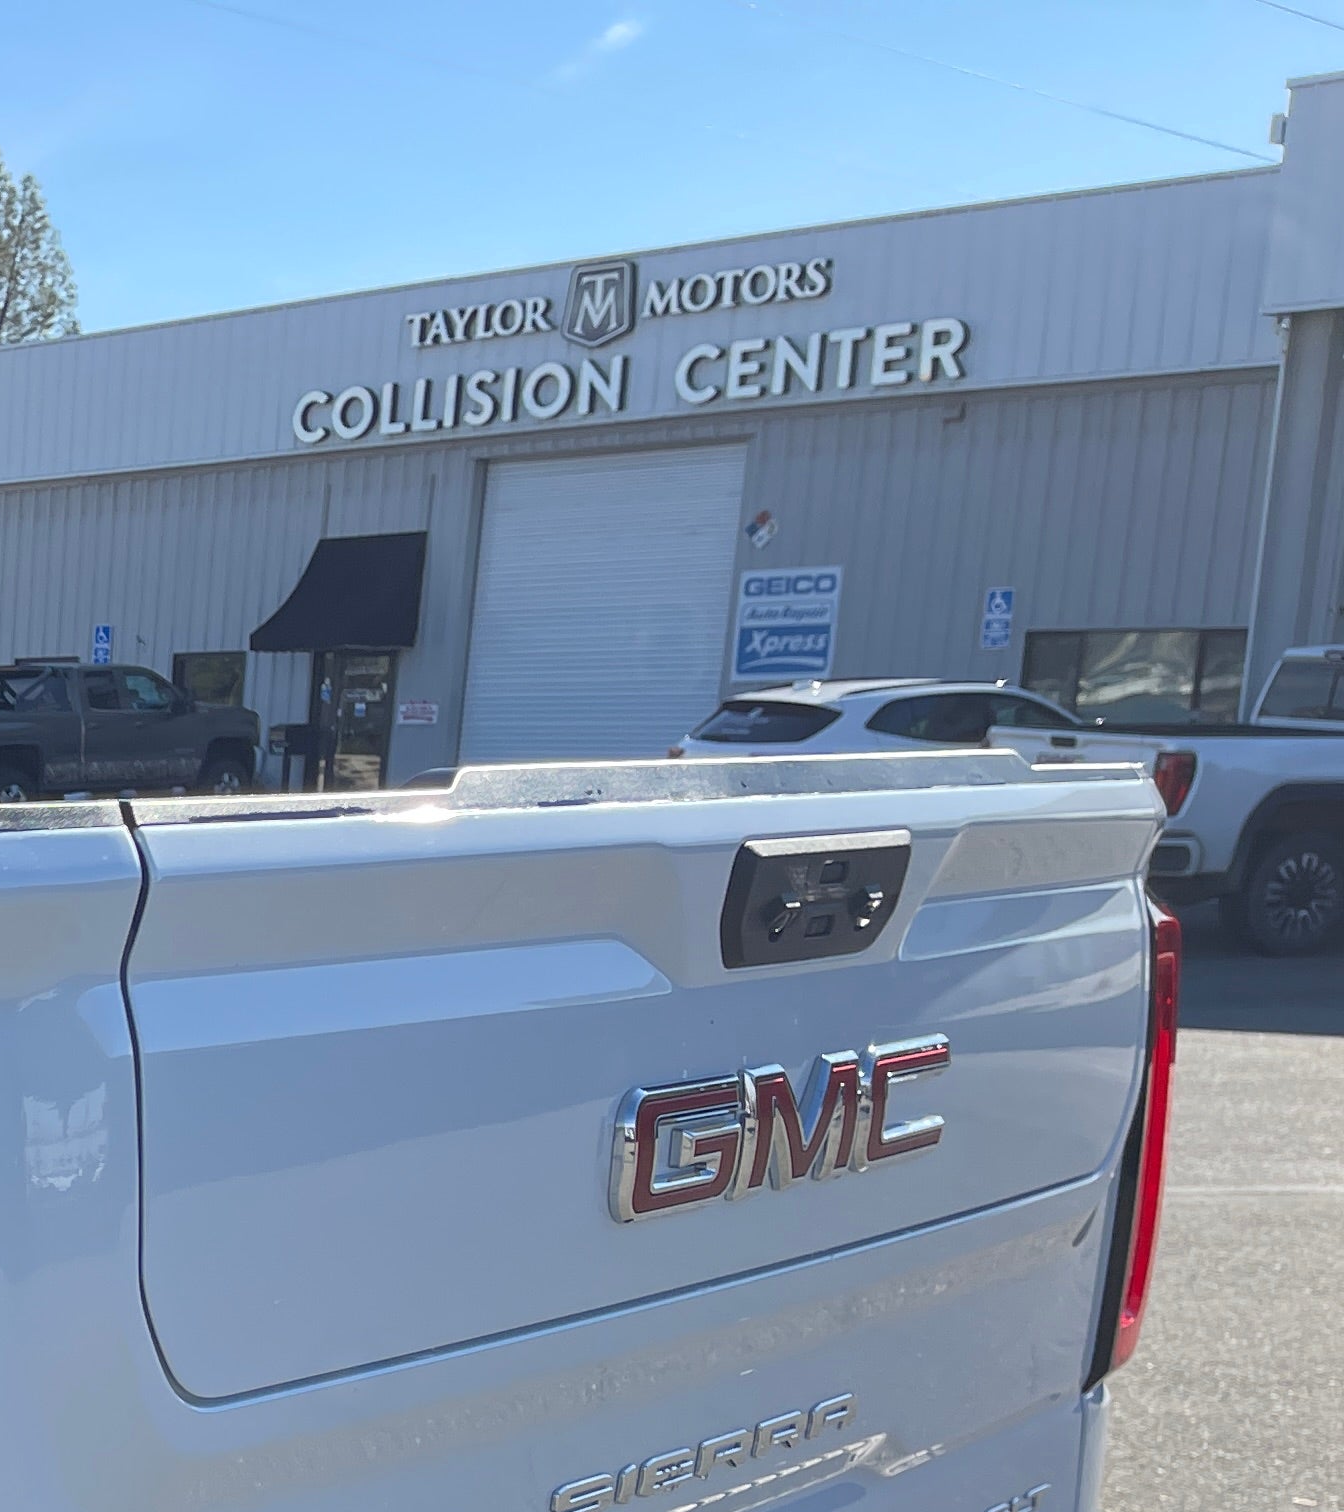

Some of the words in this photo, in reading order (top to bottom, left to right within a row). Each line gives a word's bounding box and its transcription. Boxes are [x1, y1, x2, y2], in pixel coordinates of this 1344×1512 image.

[406, 295, 553, 348] TAYLOR
[641, 257, 833, 320] MOTORS
[292, 354, 629, 445] COLLISION
[675, 317, 968, 404] CENTER
[744, 574, 837, 597] GEICO
[745, 629, 828, 657] Xpress
[609, 1032, 951, 1223] GMC
